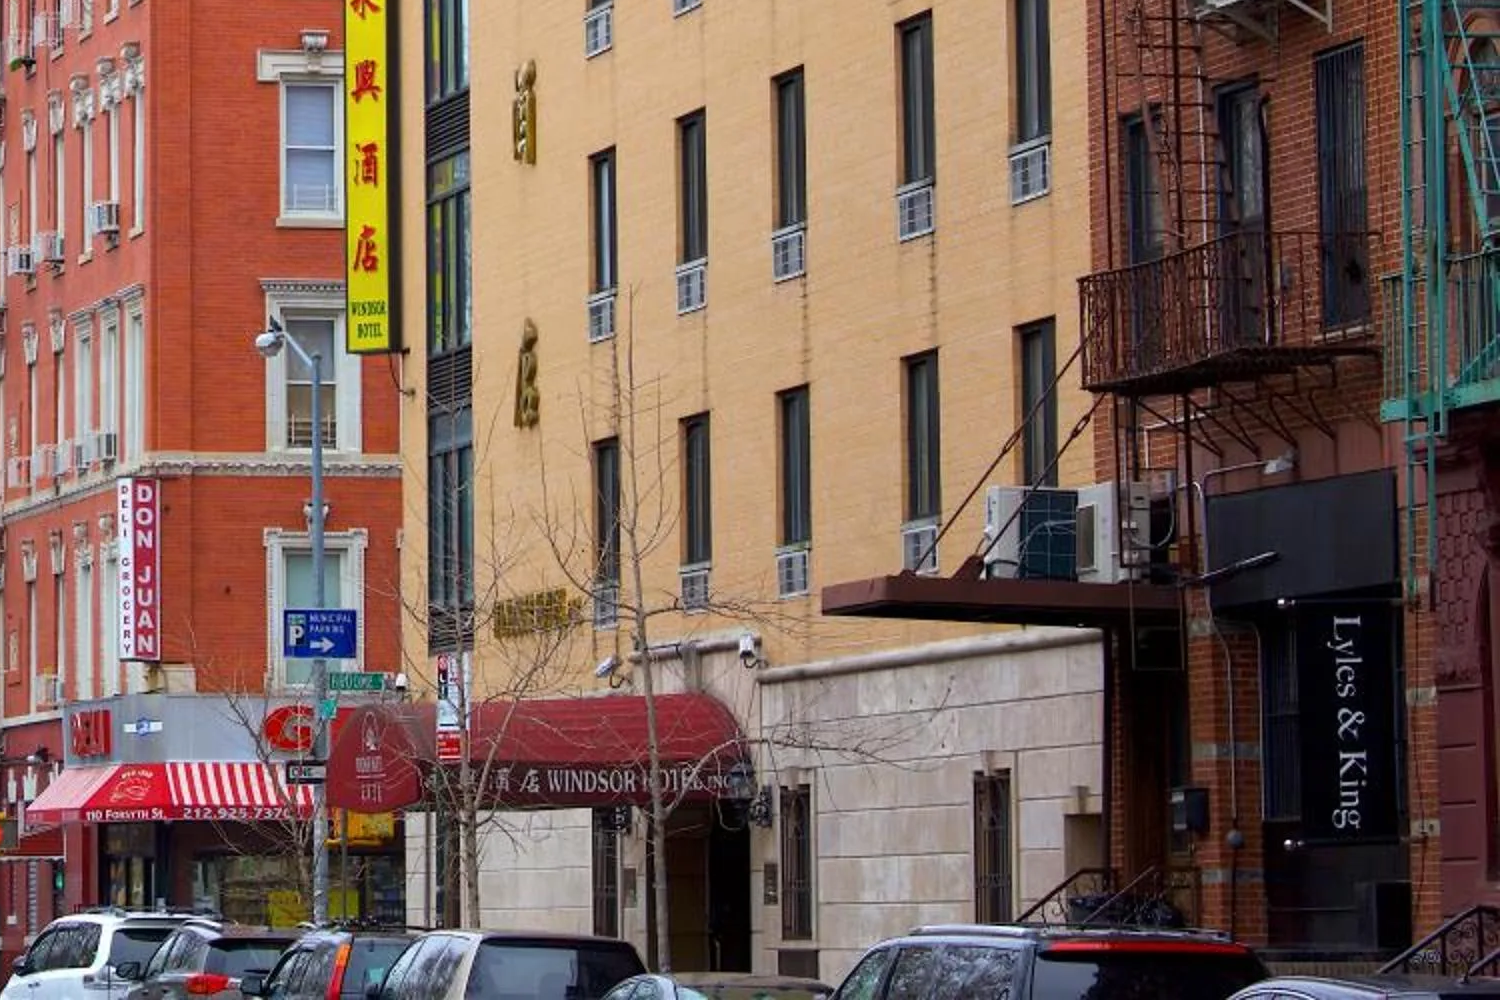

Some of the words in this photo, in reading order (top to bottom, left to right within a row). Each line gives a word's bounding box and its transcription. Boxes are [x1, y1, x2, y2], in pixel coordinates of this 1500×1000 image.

[120, 485, 129, 538] DELI
[136, 485, 153, 548] DON
[121, 557, 131, 655] GROCERY
[137, 565, 153, 653] JUAN
[1327, 615, 1363, 697] Lyles
[1337, 708, 1366, 741] &
[549, 768, 636, 793] WINDSOR
[1332, 749, 1367, 830] King
[86, 809, 102, 821] 110
